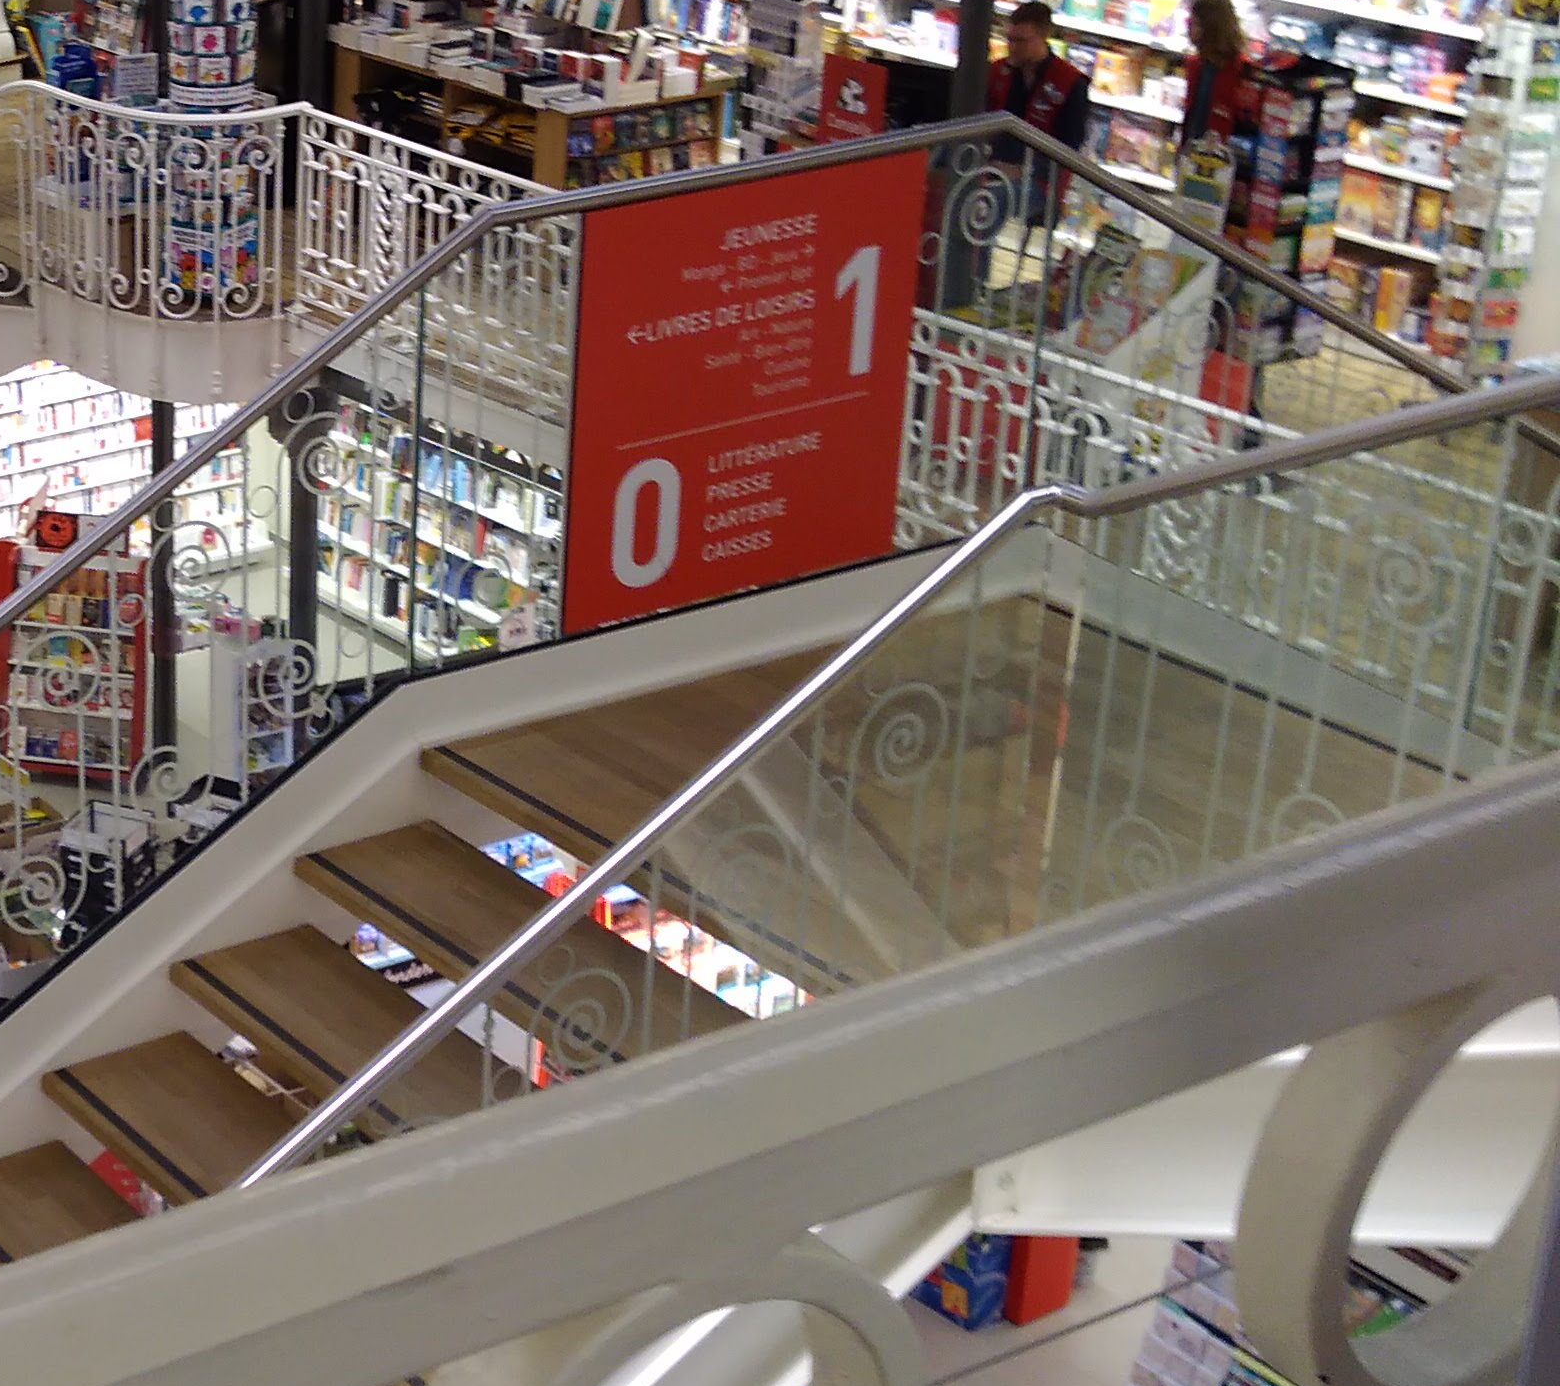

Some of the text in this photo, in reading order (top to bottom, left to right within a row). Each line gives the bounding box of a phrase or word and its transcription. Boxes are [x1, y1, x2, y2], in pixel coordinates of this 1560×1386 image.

[719, 214, 819, 251] JEUNESSE
[646, 288, 817, 342] LIVRES DE LOISIRS
[835, 245, 882, 377] 1
[707, 430, 822, 474] LITTÉRATURE
[705, 471, 774, 504] PRESSE
[610, 456, 683, 589] 0
[703, 498, 788, 535] CARTERIE
[701, 530, 773, 563] CAISSES
